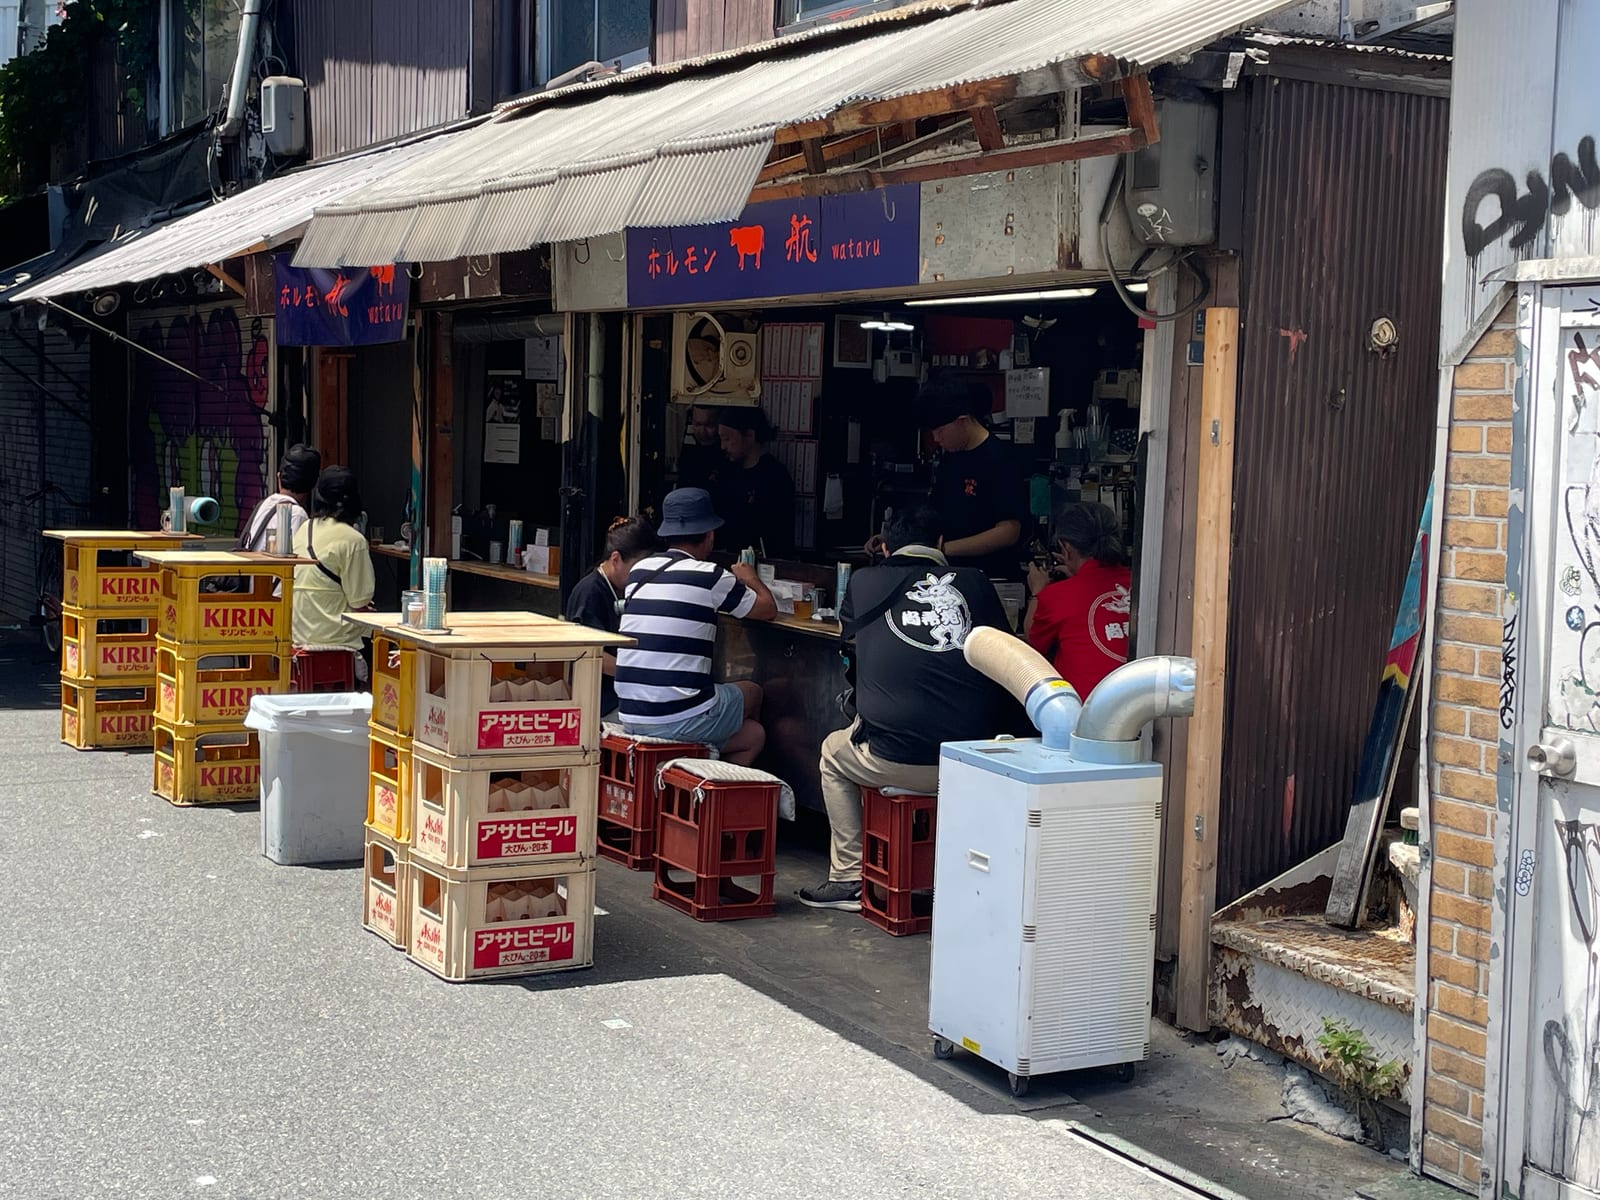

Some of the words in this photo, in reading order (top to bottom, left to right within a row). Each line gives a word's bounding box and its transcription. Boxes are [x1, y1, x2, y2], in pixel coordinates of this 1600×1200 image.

[648, 246, 717, 280] ホルモン
[785, 213, 817, 263] 航
[831, 238, 881, 261] wataru
[280, 284, 320, 310] ホルモ
[367, 302, 403, 324] wataru
[203, 608, 275, 628] KIRIN
[219, 628, 258, 637] キリンビール
[481, 712, 578, 732] アサヒビール
[480, 820, 575, 842] アサヒビール
[477, 926, 572, 952] アサヒビール
